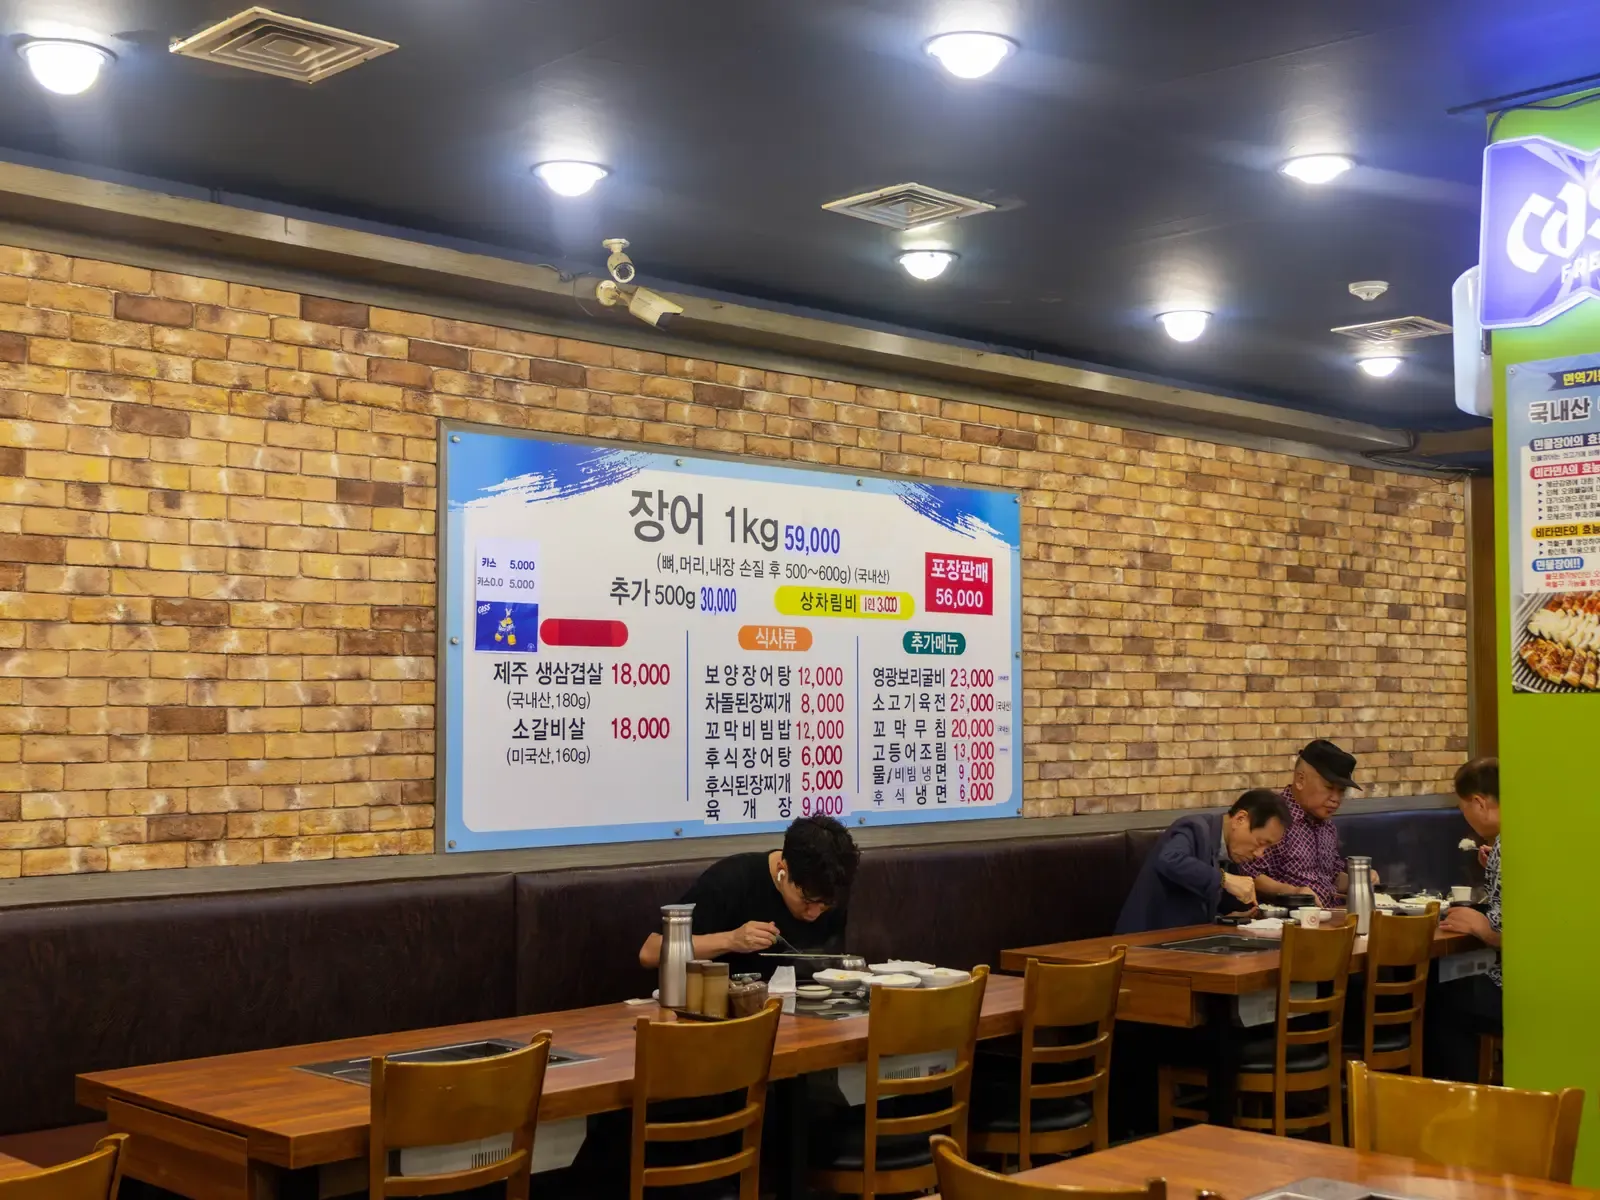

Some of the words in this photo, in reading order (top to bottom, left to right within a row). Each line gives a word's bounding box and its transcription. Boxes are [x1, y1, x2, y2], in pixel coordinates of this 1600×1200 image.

[1563, 369, 1600, 386] 면역기
[1529, 397, 1591, 424] 국내산
[1587, 433, 1600, 445] 효
[628, 489, 703, 545] 장어
[725, 506, 779, 552] 1kg
[784, 525, 841, 555] 59,000
[482, 557, 497, 568] 카스
[657, 552, 735, 577] (뼈,머리,내장
[739, 559, 764, 579] 손질
[769, 560, 781, 579] 후
[854, 568, 890, 585] (국내산)
[930, 558, 988, 584] 포장판매
[477, 576, 504, 587] 카스0.0
[610, 576, 650, 607] 추가
[655, 585, 696, 609] 500g
[700, 586, 737, 615] 30,000
[800, 591, 857, 613] 상차림비
[935, 588, 983, 609] 56,000
[755, 627, 797, 650] 식사류
[911, 632, 959, 654] 추가메뉴
[493, 661, 529, 685] 제주
[535, 661, 604, 686] 생삼겹살
[611, 662, 671, 687] 18,000
[704, 664, 792, 687] 보양장어탕
[798, 666, 843, 689] 12,000
[872, 667, 945, 688] 영광보리굴비
[950, 668, 994, 690] 23,000
[506, 691, 591, 711] (국내산,180g)
[705, 691, 791, 714] 차돌된장찌개
[801, 693, 845, 715] 8,000
[872, 692, 946, 712] 소고기육전
[950, 693, 994, 714] 25,000
[511, 716, 585, 741] 소갈비살
[611, 717, 670, 742] 18,000
[704, 719, 791, 741] 꼬막비빔밥
[796, 720, 844, 742] 12,000
[951, 719, 994, 740] 20,000
[506, 745, 591, 766] (미국산,160g)
[704, 746, 792, 770] 후식장어탕
[801, 745, 843, 769] 6,000
[872, 742, 946, 763] 고등어조림
[953, 741, 994, 763] 13,000
[958, 761, 995, 783] 9,000
[704, 773, 791, 798] 후식된장찌개
[801, 769, 843, 793] 5,000
[959, 782, 994, 804] 6,000
[802, 795, 844, 817] 9000
